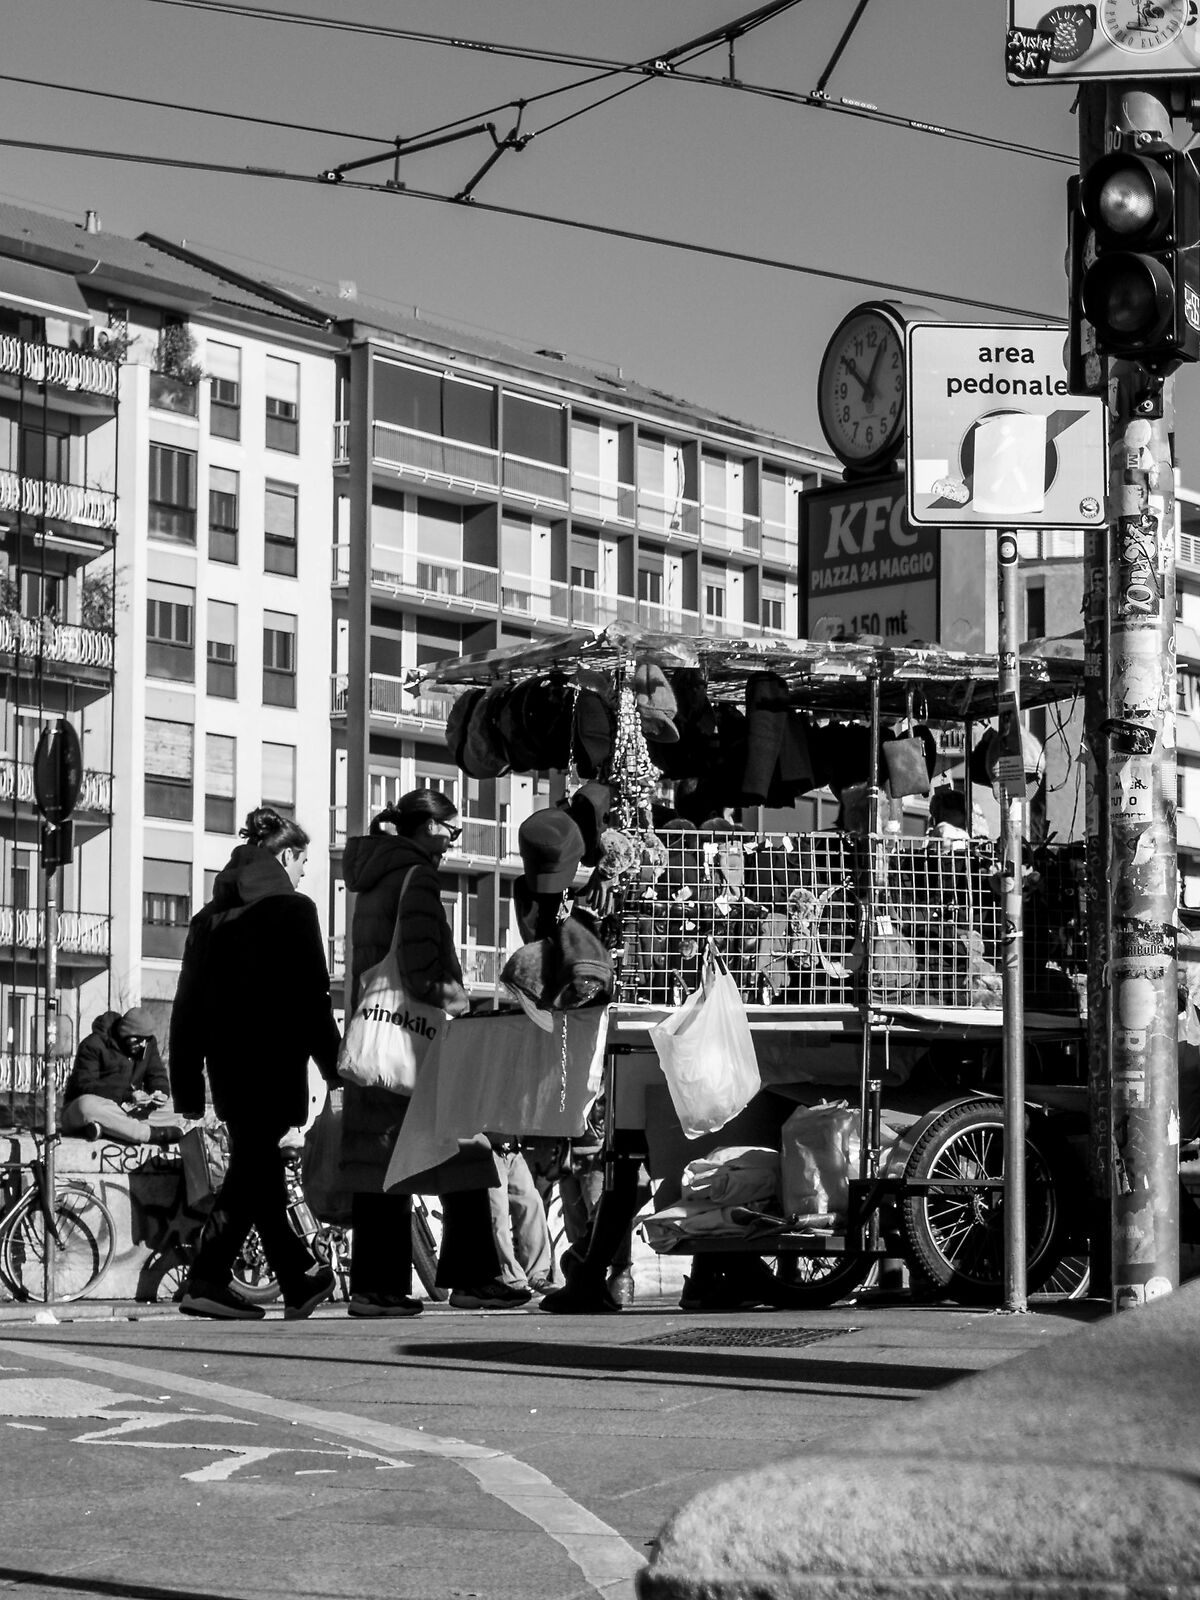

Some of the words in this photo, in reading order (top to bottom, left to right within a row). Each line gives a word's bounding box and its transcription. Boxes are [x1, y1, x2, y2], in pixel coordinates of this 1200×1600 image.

[1049, 11, 1083, 25] ULULA
[866, 331, 877, 348] 12
[854, 340, 863, 357] 11
[978, 346, 1035, 363] area
[891, 352, 899, 369] 2
[840, 383, 848, 400] 9
[895, 376, 902, 392] 3
[948, 374, 1068, 397] pedonale
[842, 405, 850, 423] 8
[889, 401, 896, 418] 4
[852, 422, 859, 439] 7
[880, 417, 887, 434] 5
[865, 426, 873, 443] 6
[824, 496, 918, 559] KFC
[811, 563, 858, 590] PIAZZA
[860, 565, 877, 582] 24
[879, 556, 933, 579] MAGGIO
[851, 613, 880, 635] 150
[886, 610, 908, 636] mt
[363, 1003, 437, 1041] vinokilo
